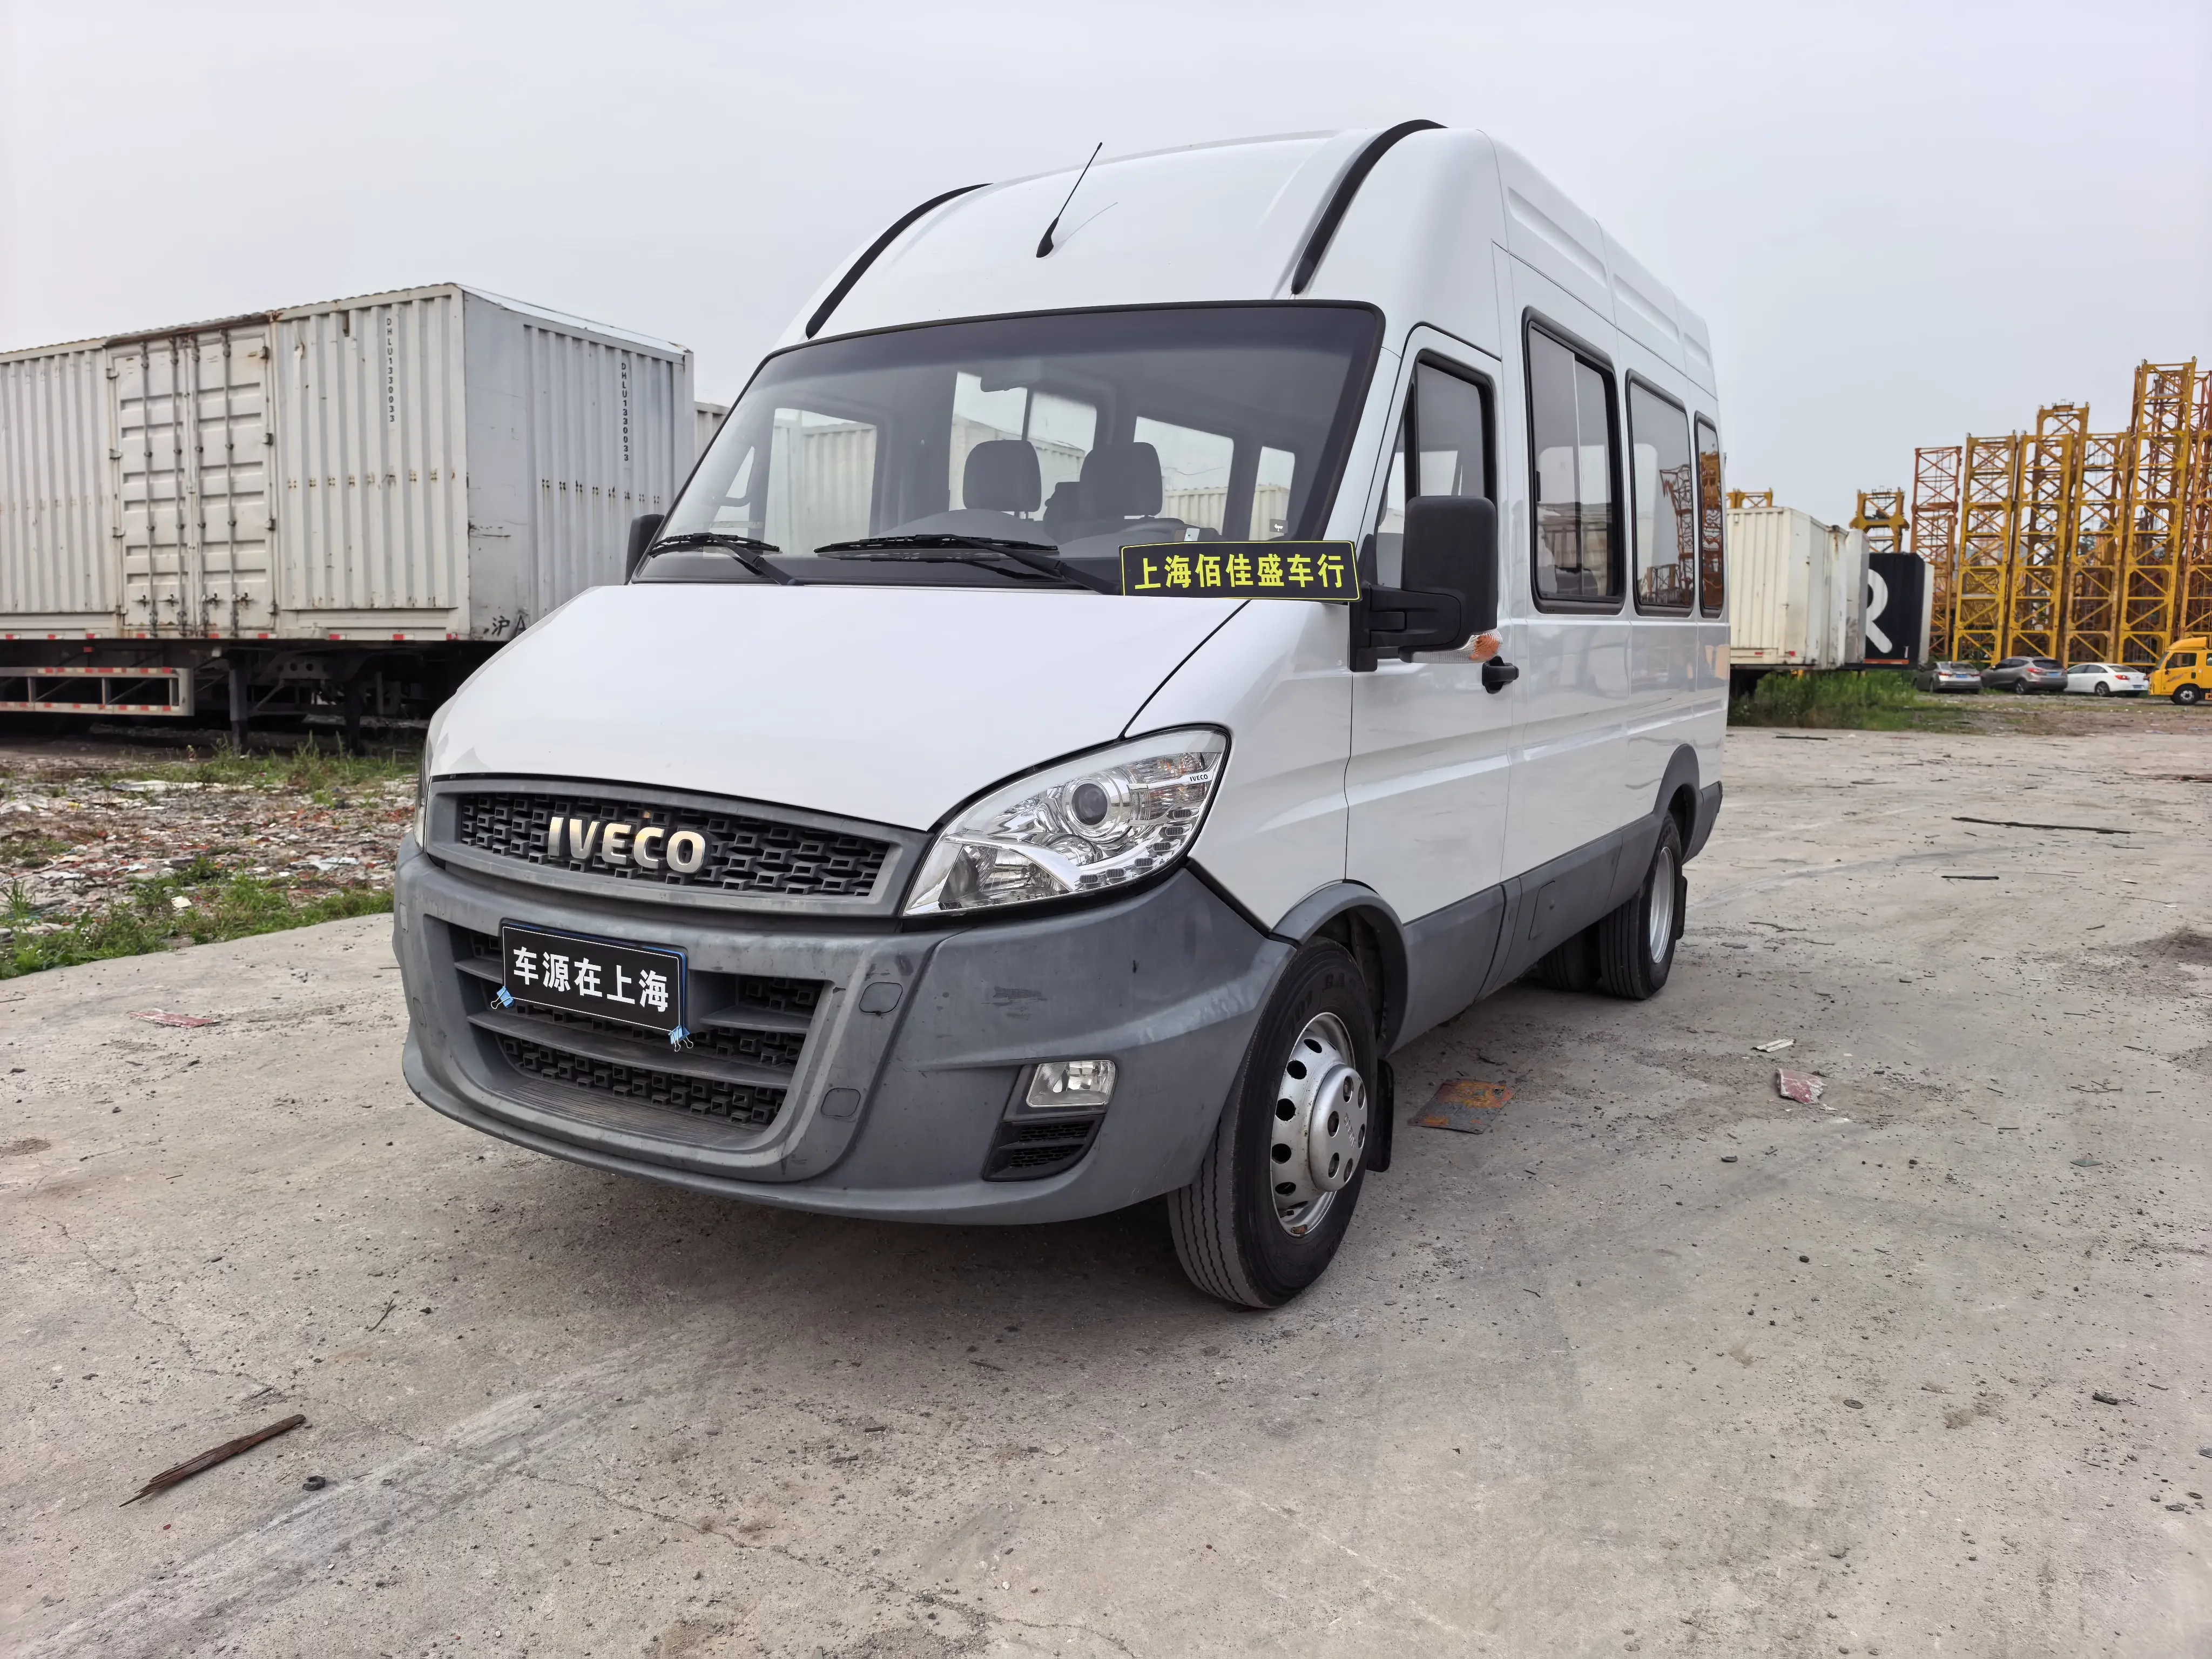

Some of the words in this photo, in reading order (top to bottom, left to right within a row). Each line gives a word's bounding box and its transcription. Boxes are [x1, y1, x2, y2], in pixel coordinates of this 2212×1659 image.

[386, 318, 395, 422] DHLU1330033
[621, 362, 629, 462] DHLU1330033
[1135, 554, 1344, 589] 上海佰佳盛车行
[547, 817, 706, 874] IVECO
[514, 947, 669, 1012] 车源在上海
